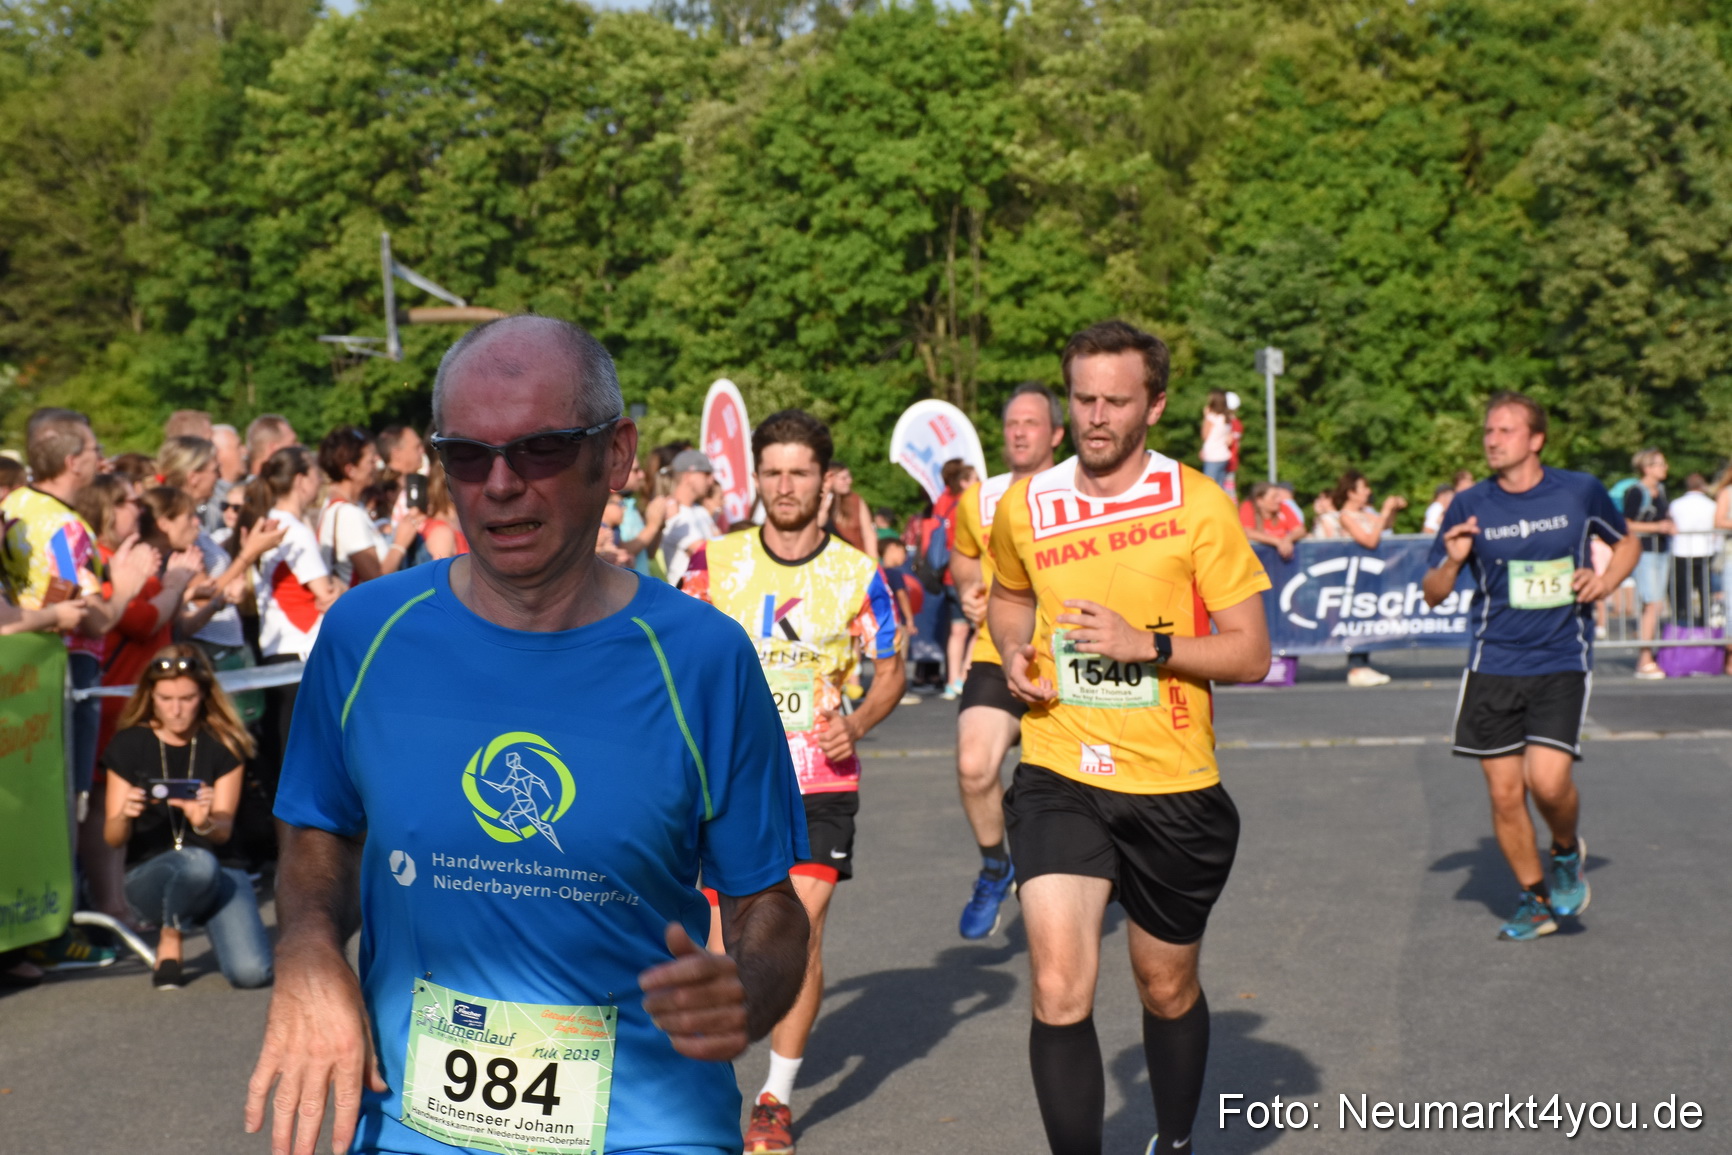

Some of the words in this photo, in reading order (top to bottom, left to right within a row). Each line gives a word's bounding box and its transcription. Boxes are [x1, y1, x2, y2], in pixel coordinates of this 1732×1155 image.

[1035, 537, 1101, 570] MAX
[1108, 519, 1186, 552] BÖGL
[1525, 577, 1562, 594] 715
[1331, 616, 1467, 638] AUTOMOBILE
[1068, 658, 1142, 687] 1540
[432, 852, 606, 883] Handwerkskammer
[434, 875, 639, 907] Niederbayern-Oberpfalz
[437, 1017, 517, 1047] firmenlauf
[563, 1048, 600, 1061] 2019
[443, 1049, 561, 1116] 984
[412, 1106, 486, 1134] Handwerkskammer
[487, 1126, 590, 1147] Niederbayern-Oberpfalz
[427, 1096, 510, 1128] Eichenseer
[515, 1116, 574, 1135] Johann
